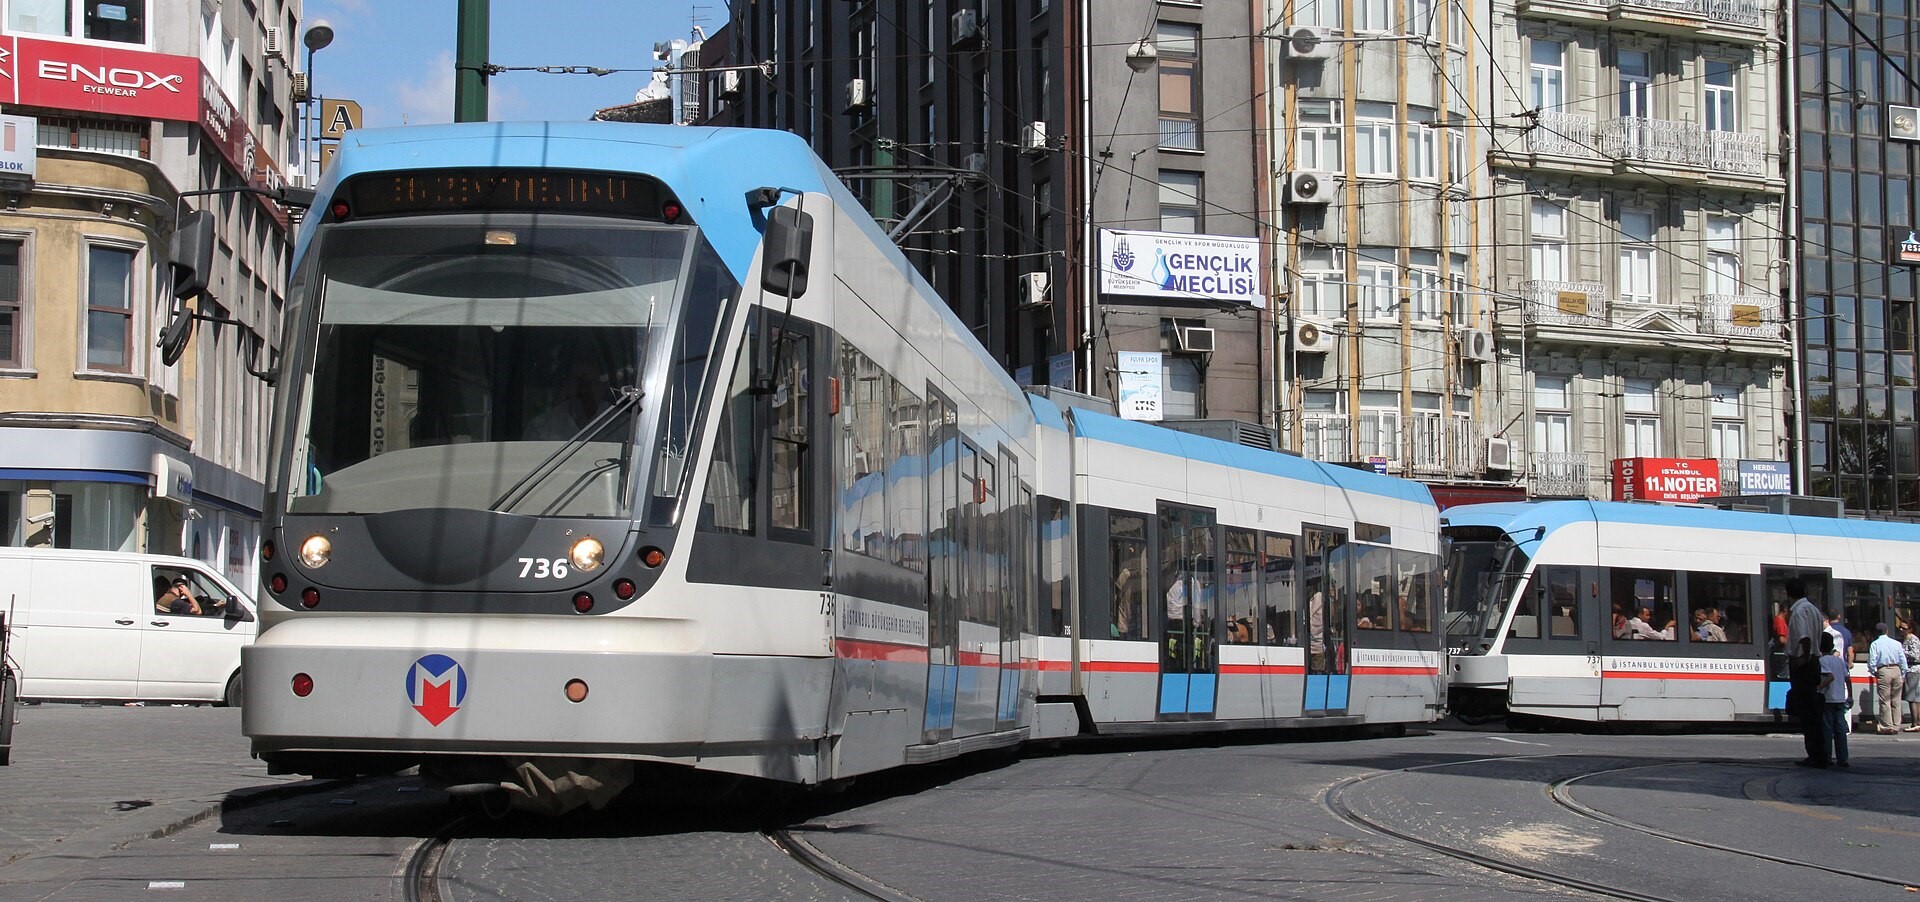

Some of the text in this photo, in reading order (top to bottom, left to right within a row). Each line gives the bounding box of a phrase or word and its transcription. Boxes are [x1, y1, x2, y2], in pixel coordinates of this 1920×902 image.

[38, 59, 180, 93] ENOX
[83, 85, 137, 97] EYEWEAR
[1155, 238, 1182, 247] GENÇLİK
[1169, 253, 1253, 276] GENÇLİK
[1171, 273, 1253, 296] MECLİSİ
[1645, 476, 1718, 493] 11.NOTER
[517, 557, 569, 579] 736
[847, 603, 870, 629] İSTANBUL
[871, 610, 898, 635] BÜYÜKŞEHİR
[1361, 651, 1381, 662] İSTANBUL
[1448, 647, 1461, 655] 737
[1587, 656, 1600, 664] 737
[1619, 660, 1753, 671] İSTANBUL BÜYÜKŞEHİR BELEDİYESİ
